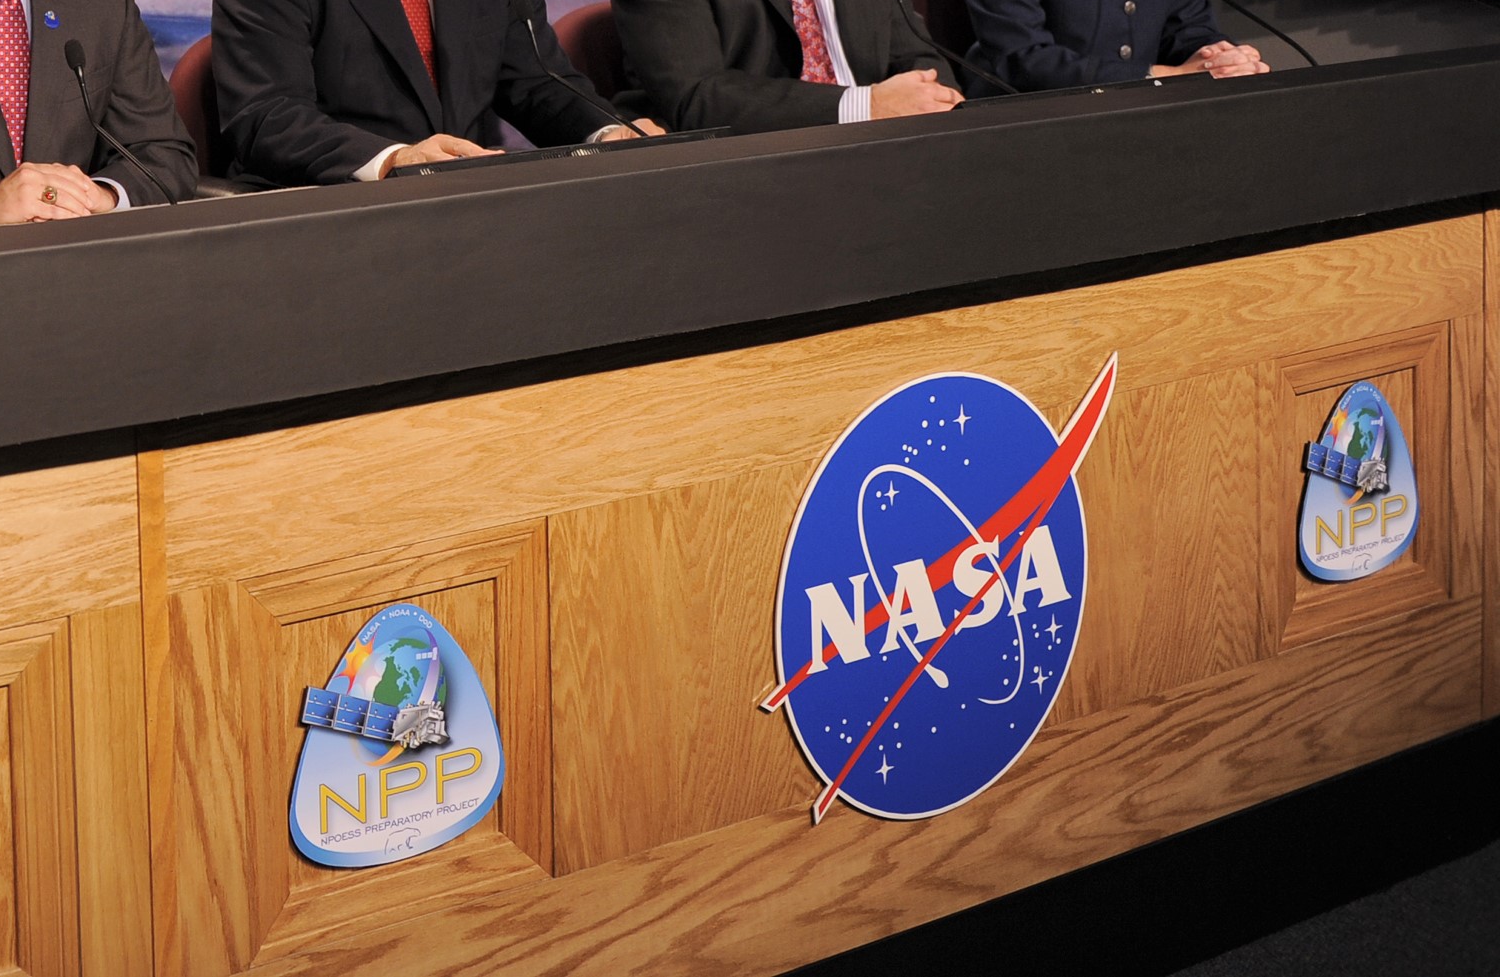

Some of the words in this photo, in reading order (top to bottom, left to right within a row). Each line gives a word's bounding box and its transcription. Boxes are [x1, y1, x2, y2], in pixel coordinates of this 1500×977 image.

[1315, 493, 1408, 555] NPP
[362, 621, 381, 643] NASA
[388, 609, 411, 619] NOAA
[418, 614, 433, 629] DoD
[805, 524, 1072, 674] NASA
[319, 746, 483, 835] NPP
[320, 828, 362, 847] NPOESS
[364, 809, 434, 836] PREPARATORY
[436, 797, 481, 817] PROJECT
